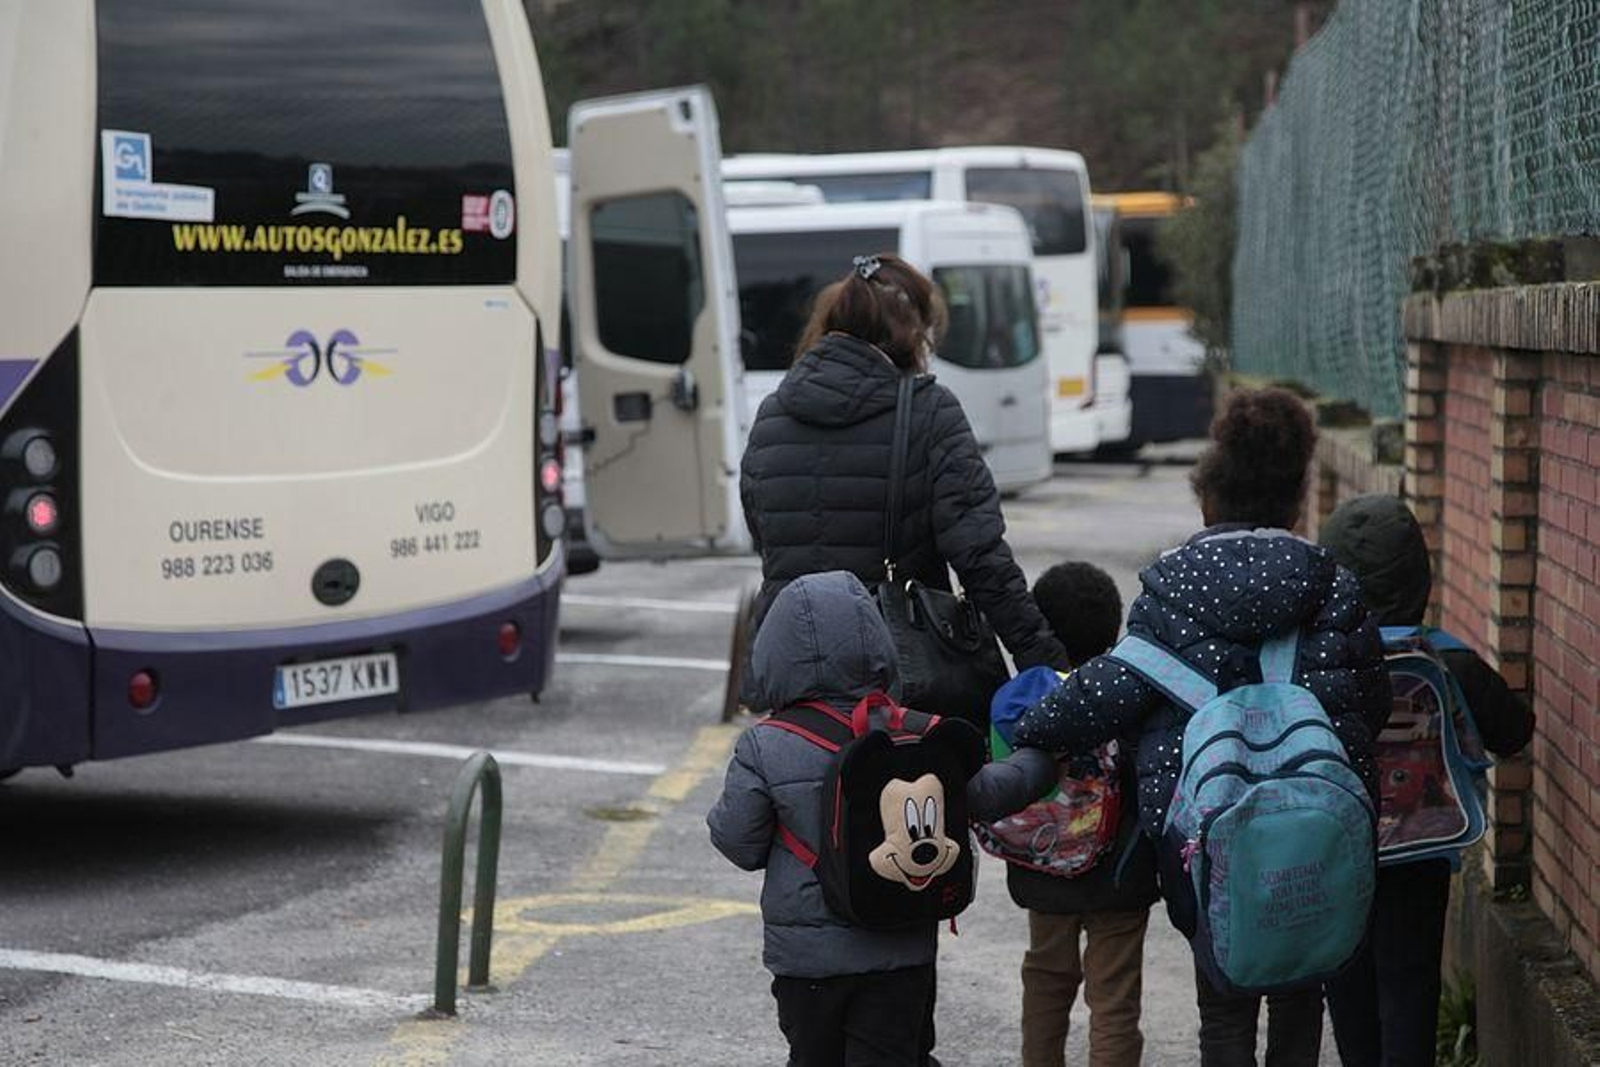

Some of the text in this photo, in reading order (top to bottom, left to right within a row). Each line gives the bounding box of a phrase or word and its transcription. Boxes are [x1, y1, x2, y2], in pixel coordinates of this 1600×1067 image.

[415, 502, 455, 523] VIGO
[169, 518, 264, 543] OURENSE
[390, 530, 481, 558] 986 441 222
[161, 551, 273, 579] 988 223 036
[291, 664, 343, 699] 1537
